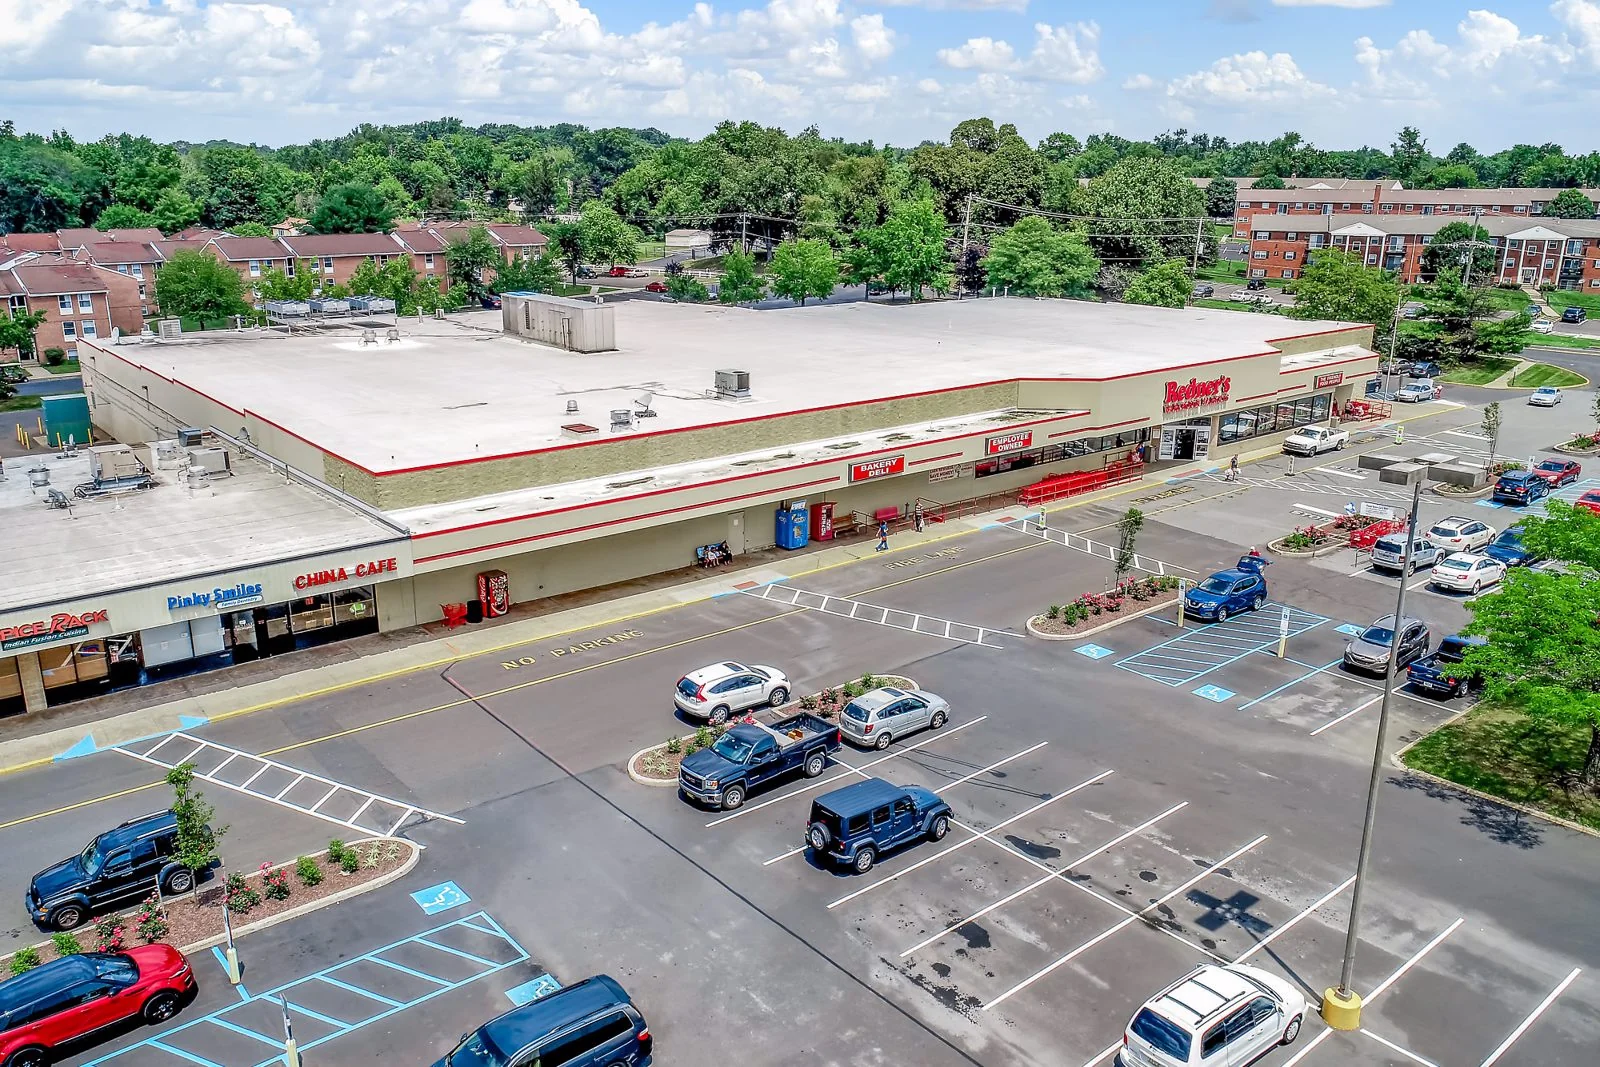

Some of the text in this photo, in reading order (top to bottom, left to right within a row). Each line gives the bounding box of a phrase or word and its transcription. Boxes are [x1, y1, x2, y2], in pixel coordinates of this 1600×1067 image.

[1165, 375, 1231, 403] Redner's
[992, 434, 1029, 446] EMPLOYEE
[998, 441, 1024, 452] OWNED
[860, 459, 898, 472] BAKERY
[868, 467, 890, 477] DELI
[884, 546, 966, 570] FIRE LANE
[295, 558, 397, 590] CHINA CAFE
[167, 583, 263, 611] Pinky Smiles
[49, 609, 109, 634] RACK
[4, 627, 87, 649] Indian Fusion Cuisine
[501, 628, 644, 670] NO PARKING
